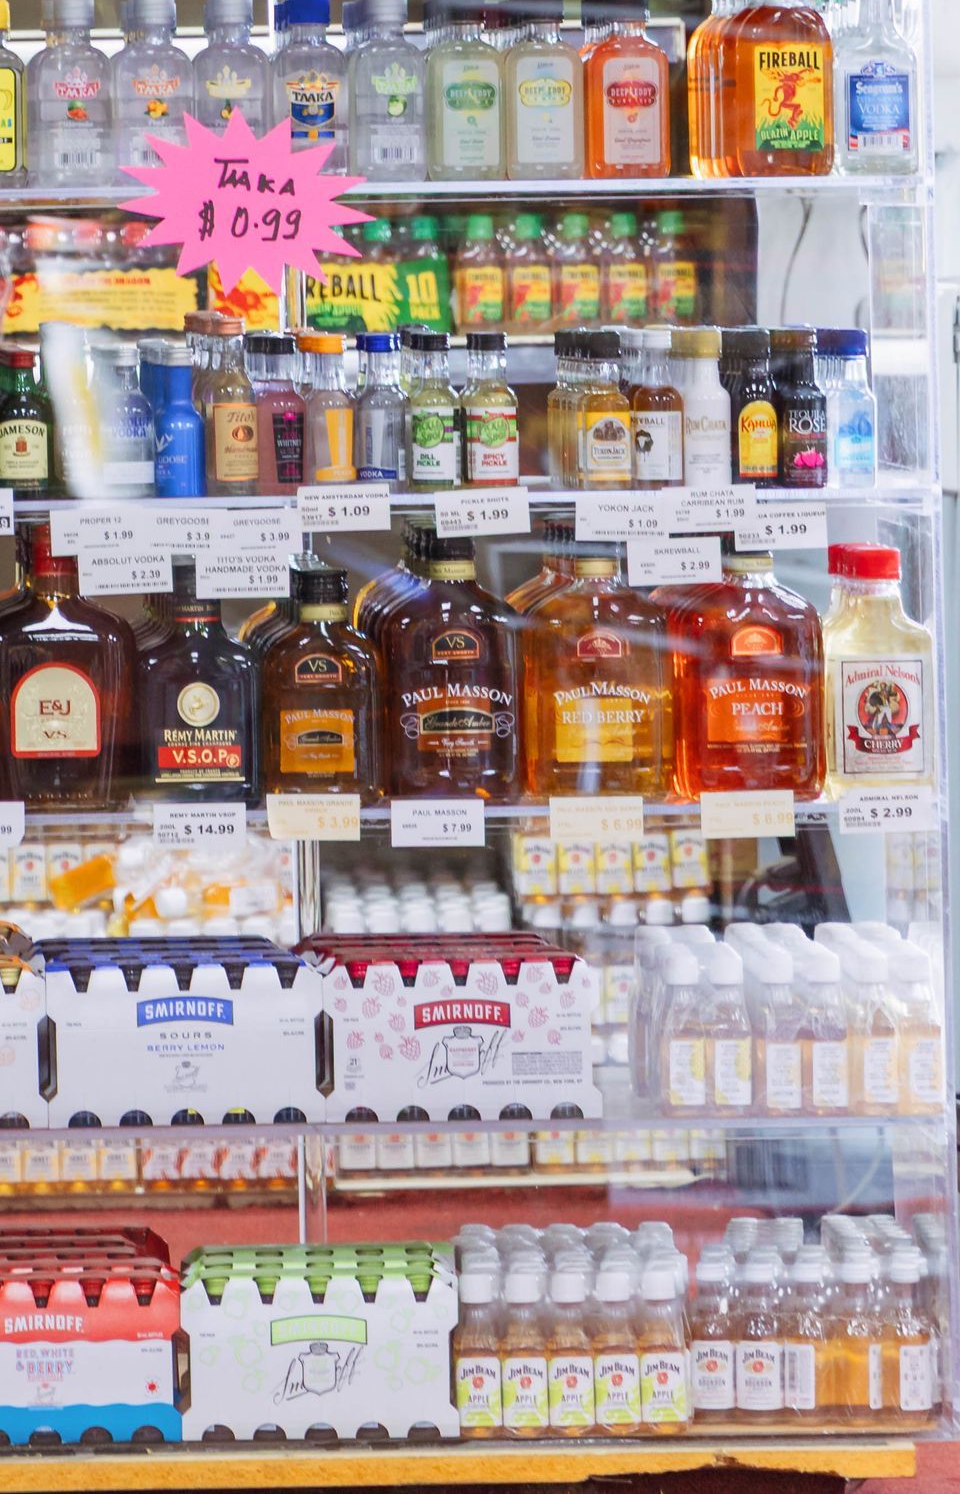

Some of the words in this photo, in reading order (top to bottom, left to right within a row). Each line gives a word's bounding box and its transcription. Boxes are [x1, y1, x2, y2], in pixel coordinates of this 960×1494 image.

[758, 49, 821, 73] FIREBALL
[198, 199, 215, 241] $
[230, 208, 302, 241] 0.99
[406, 271, 436, 299] 10
[339, 504, 371, 517] 1.09
[478, 508, 510, 521] 1.99
[598, 505, 627, 513] YOKON
[630, 505, 654, 514] JACK
[80, 517, 107, 525] PROPER
[653, 546, 701, 556] SKREWBALL
[91, 557, 128, 567] ABSOLUT
[133, 555, 166, 565] VODKA
[205, 565, 254, 574] HANDMADE
[256, 564, 288, 574] VODKA
[446, 635, 466, 650] VS
[310, 658, 328, 673] VS
[400, 684, 444, 708] PAUL
[446, 681, 514, 707] MASSON
[553, 684, 590, 706] PAUL
[590, 680, 652, 705] MASSON
[709, 680, 748, 699] PAUL
[749, 677, 807, 699] MASSON
[38, 698, 72, 717] E&J
[731, 701, 784, 717] PEACH
[561, 709, 593, 724] RED
[595, 708, 644, 724] BERRY
[863, 737, 903, 750] CHERRY
[859, 795, 888, 803] ADMIRAL
[891, 794, 919, 802] NELSON
[412, 809, 429, 817] PAUL
[431, 808, 468, 817] MASSON
[881, 805, 913, 819] 2.99
[196, 823, 236, 836] 14.99
[144, 1000, 227, 1021] SMIRNOFF
[420, 1002, 504, 1026] SMIRNOFF
[159, 1031, 213, 1041] SOURS
[3, 1315, 86, 1335] SMIRNOFF
